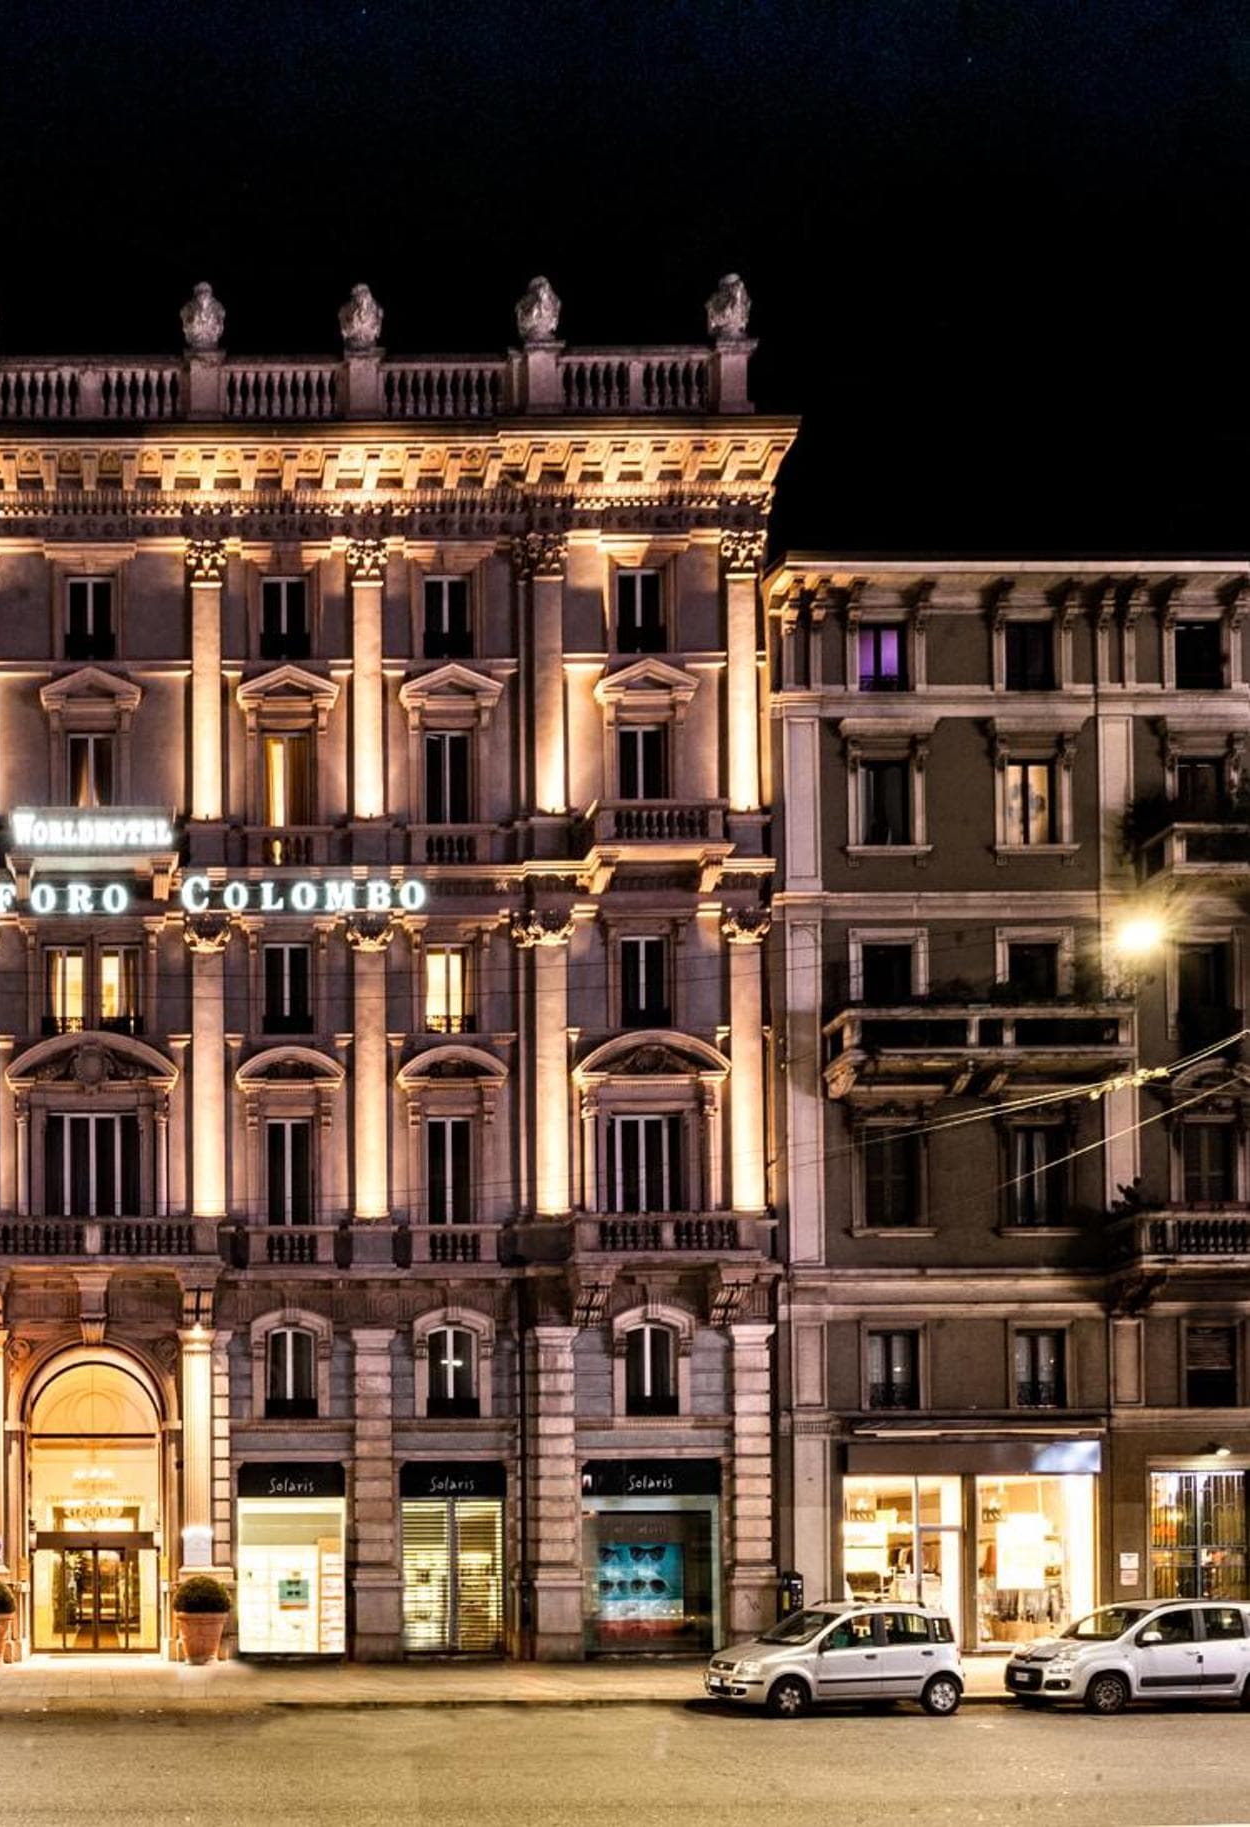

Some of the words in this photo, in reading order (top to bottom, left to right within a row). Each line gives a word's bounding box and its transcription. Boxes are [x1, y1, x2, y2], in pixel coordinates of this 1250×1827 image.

[12, 812, 173, 846] WORLDHOTEL
[181, 876, 427, 912] COLOMBO
[268, 1477, 315, 1494] Solaris
[429, 1474, 475, 1493] Solaris
[627, 1473, 673, 1491] Solaris
